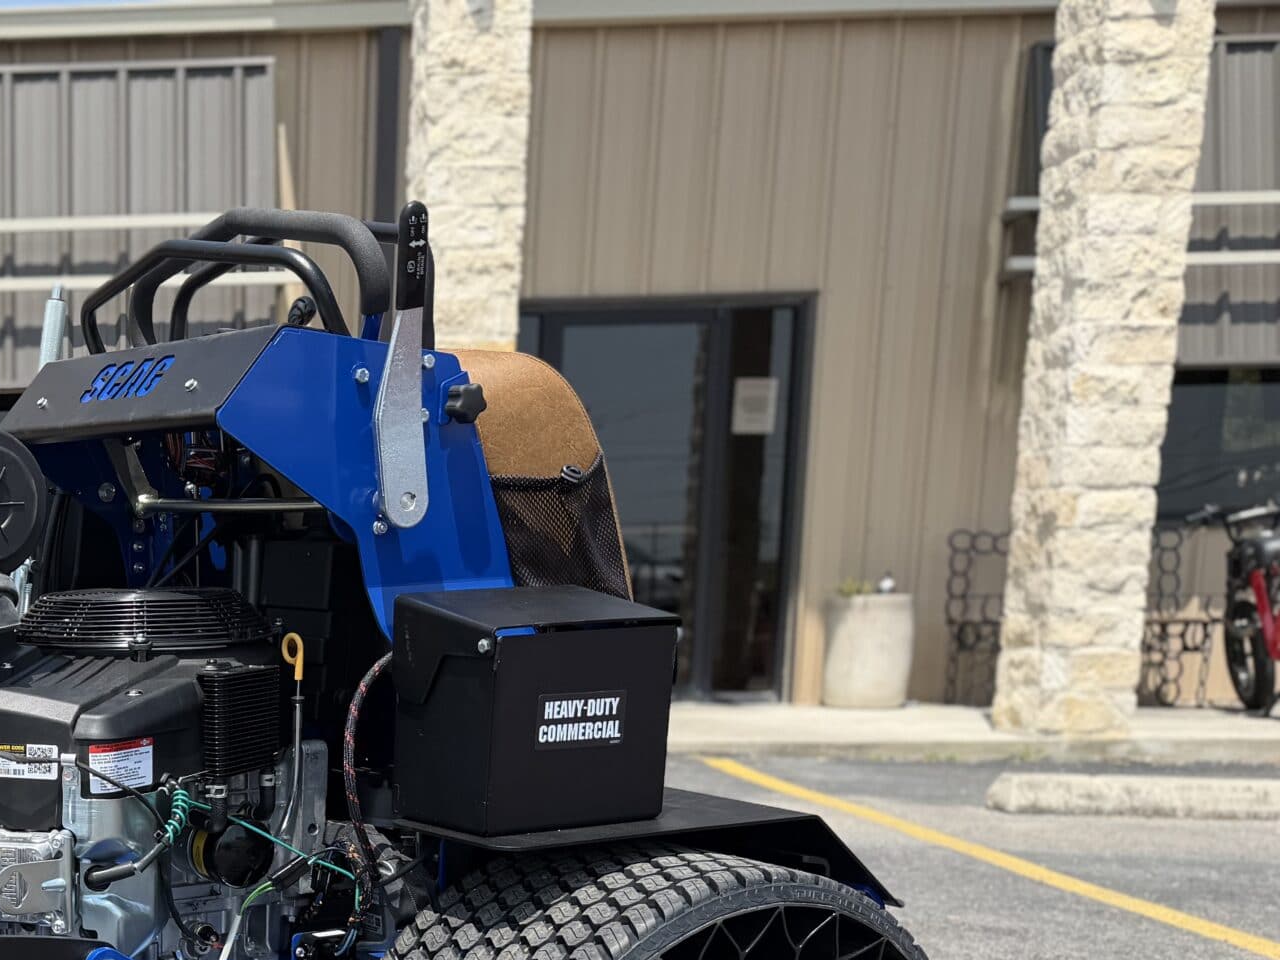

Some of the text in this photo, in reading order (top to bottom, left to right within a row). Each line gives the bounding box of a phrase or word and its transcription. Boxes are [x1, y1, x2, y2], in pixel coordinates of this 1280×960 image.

[80, 354, 176, 404] SCAG
[544, 697, 620, 720] HEAVY-DUTY
[538, 720, 621, 743] COMMERCIAL
